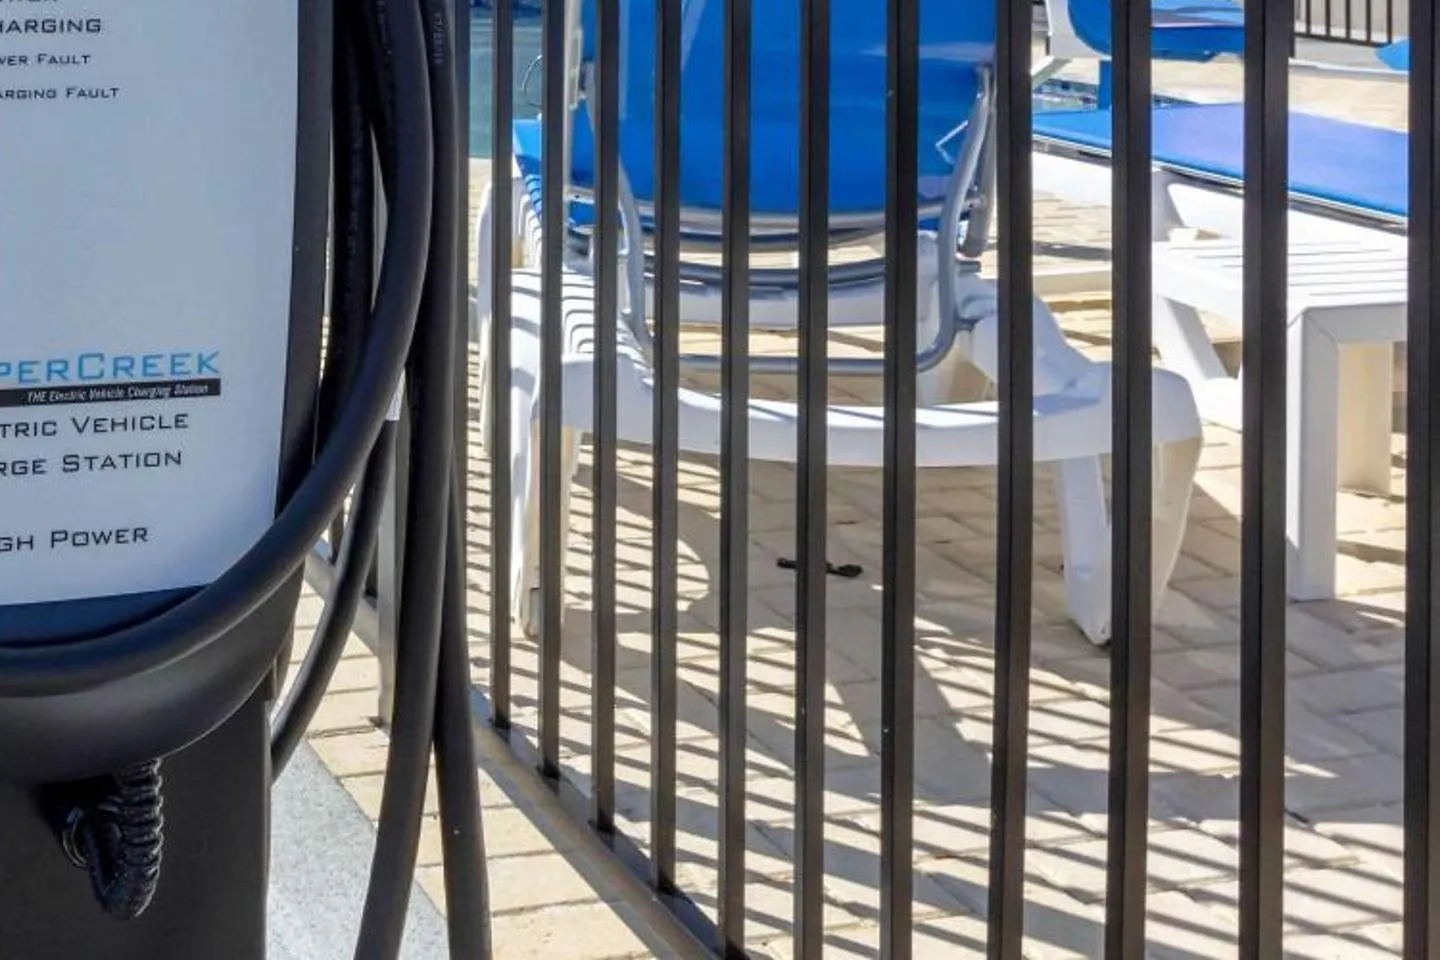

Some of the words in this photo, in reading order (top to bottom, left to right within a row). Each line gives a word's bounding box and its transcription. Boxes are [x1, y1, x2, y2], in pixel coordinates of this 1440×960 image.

[37, 52, 92, 66] FAULT
[65, 85, 121, 100] FAULT
[26, 392, 47, 404] THE
[71, 412, 190, 435] VEHICLE
[61, 448, 183, 473] STATION
[50, 526, 149, 549] POWER
